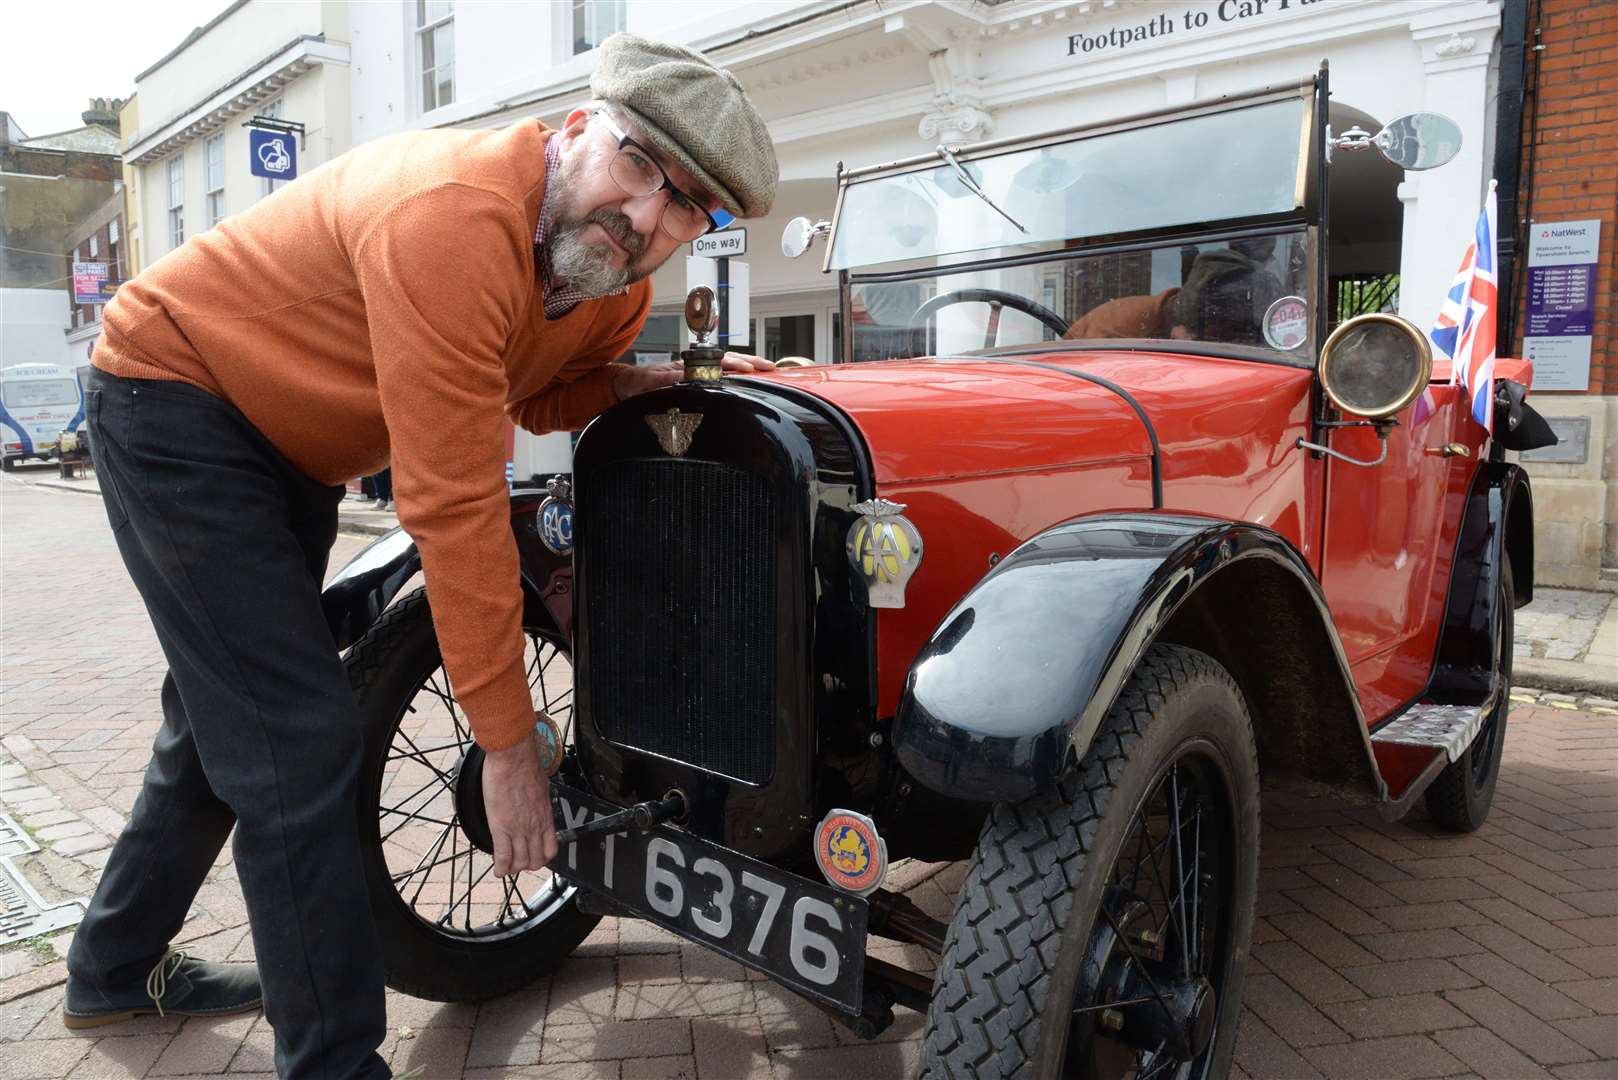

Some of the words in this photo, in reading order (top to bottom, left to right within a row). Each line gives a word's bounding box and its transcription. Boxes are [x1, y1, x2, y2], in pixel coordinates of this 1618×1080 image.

[1067, 13, 1174, 56] Footpath
[1184, 10, 1208, 30] to
[1217, 0, 1270, 22] Car
[696, 239, 717, 251] One
[720, 237, 741, 249] way
[1551, 228, 1586, 237] NatWest
[543, 505, 572, 545] RAC
[645, 837, 843, 986] 6376
